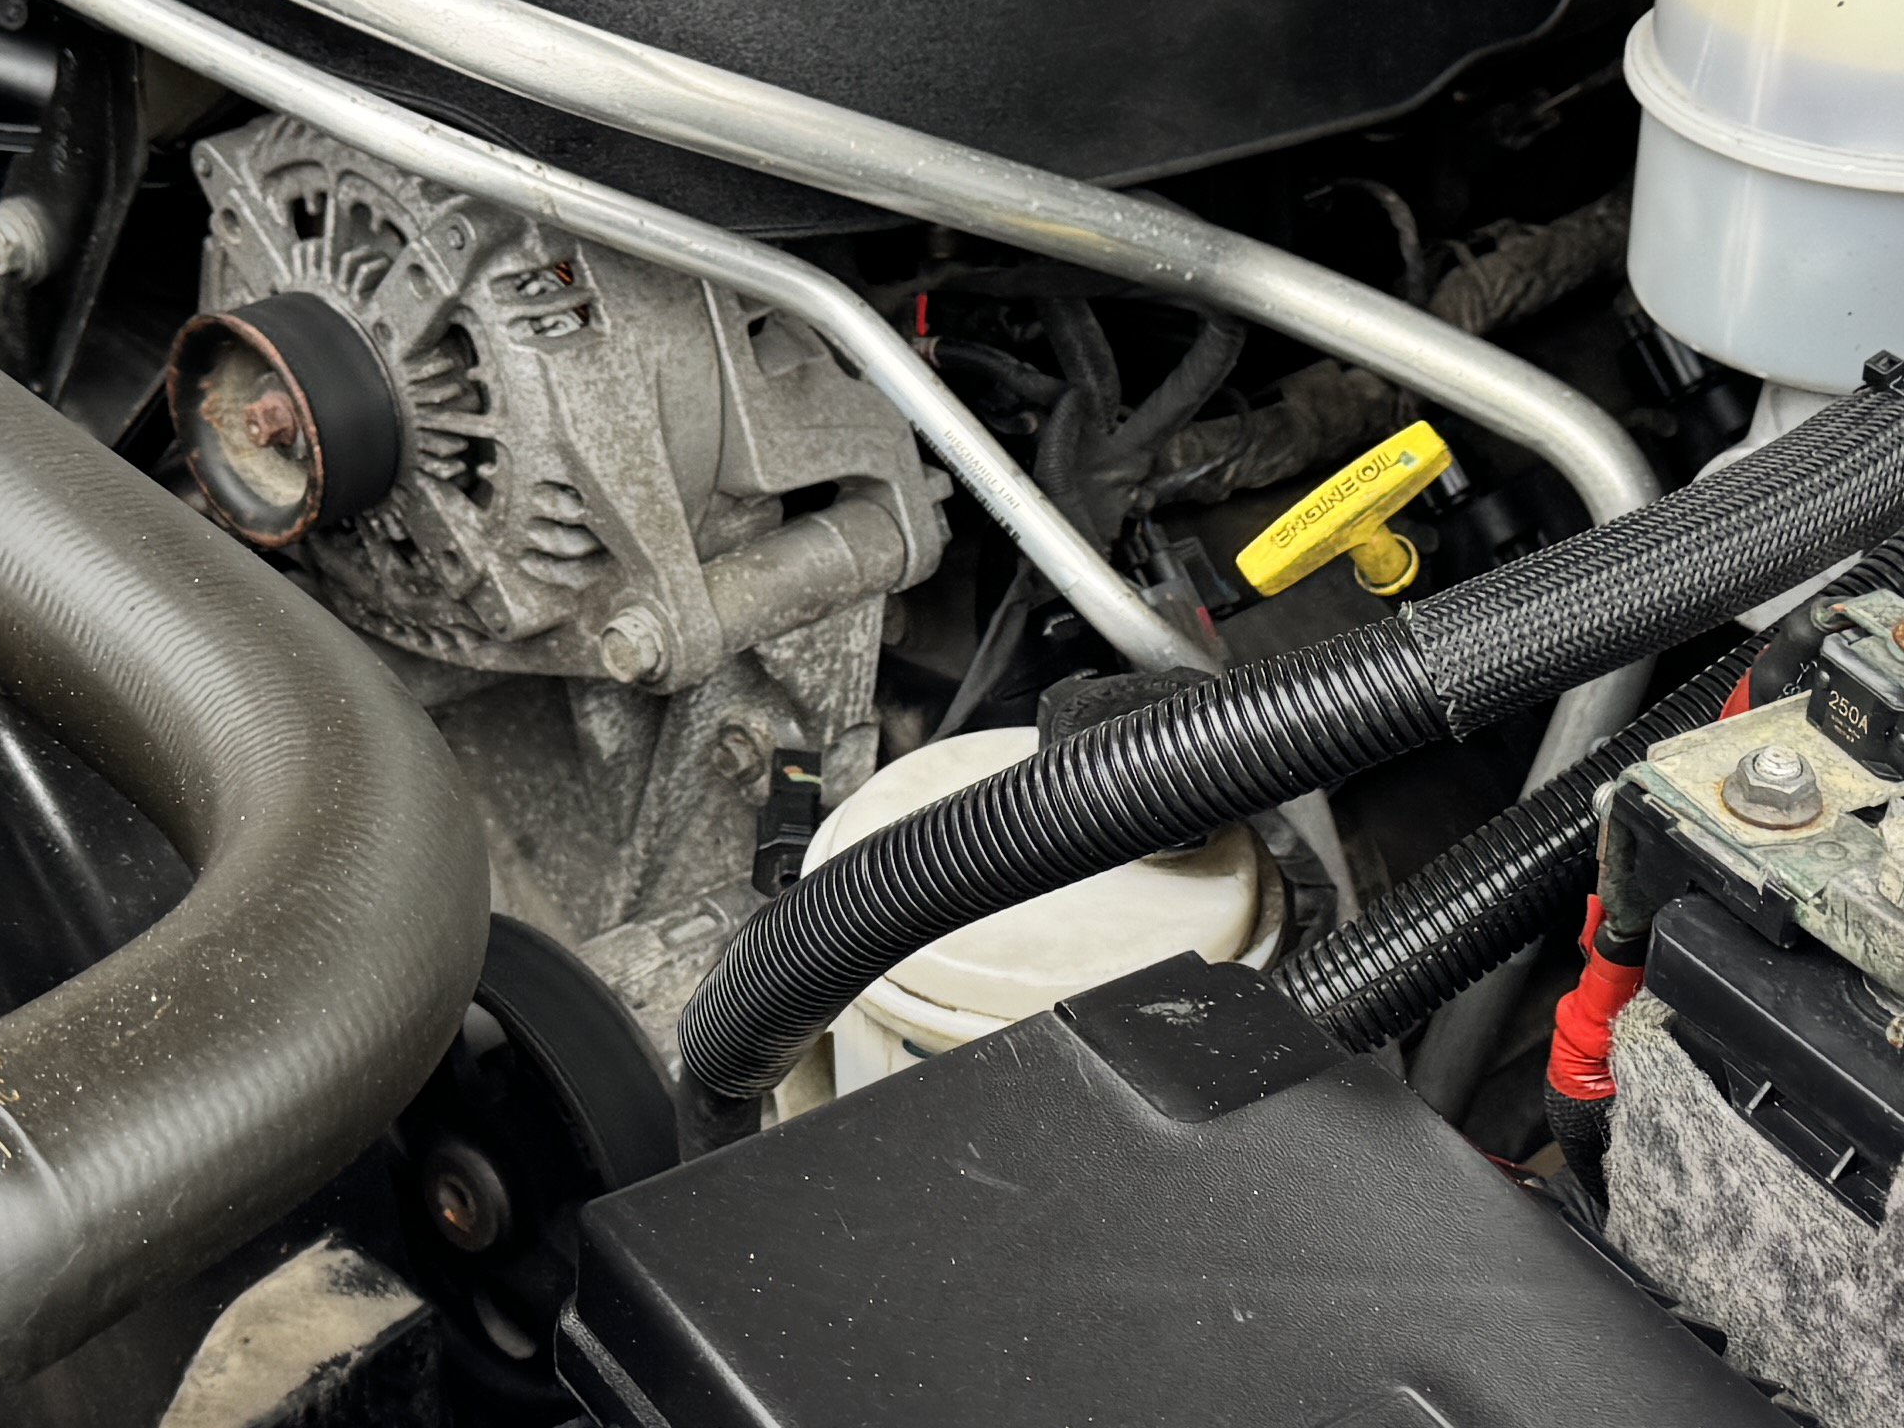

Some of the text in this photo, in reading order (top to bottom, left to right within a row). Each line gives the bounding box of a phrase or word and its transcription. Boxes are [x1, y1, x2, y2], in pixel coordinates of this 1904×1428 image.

[1269, 450, 1400, 549] ENGINE OIL
[1828, 689, 1869, 736] 250A
